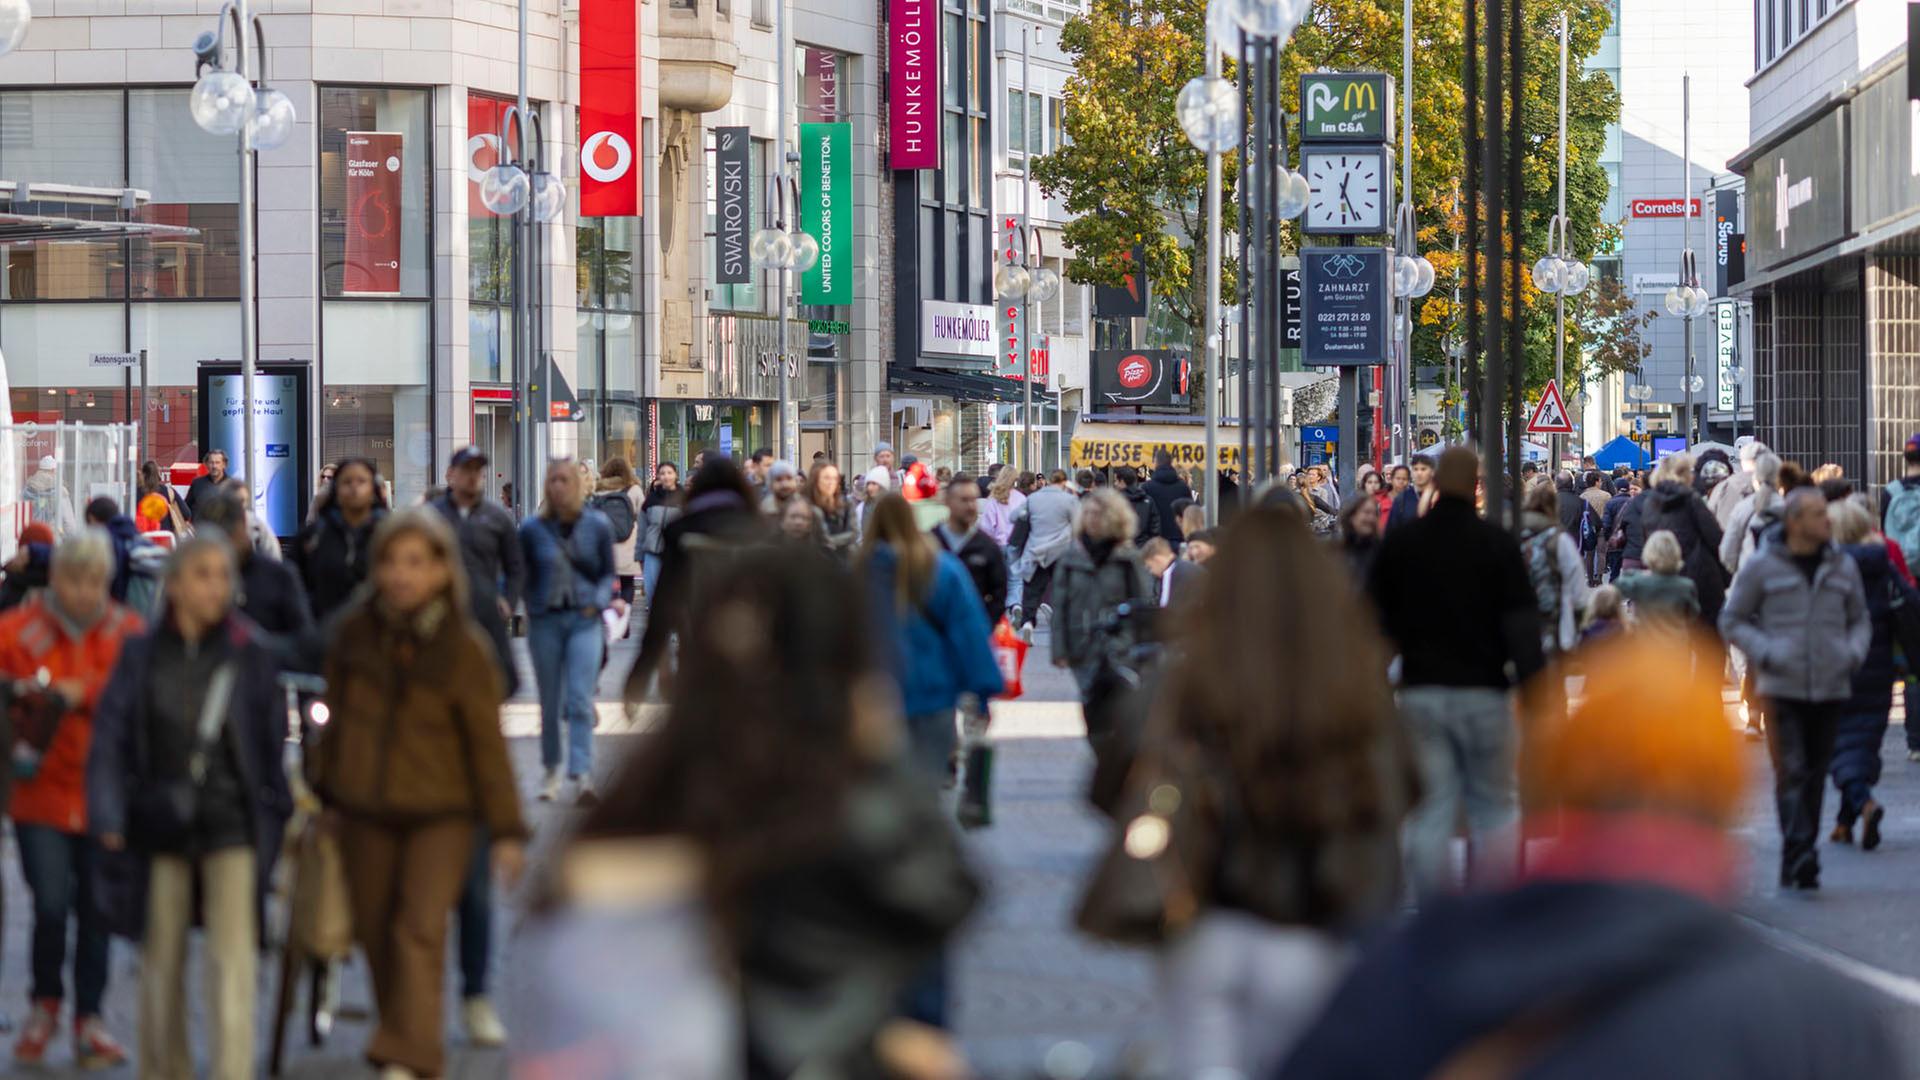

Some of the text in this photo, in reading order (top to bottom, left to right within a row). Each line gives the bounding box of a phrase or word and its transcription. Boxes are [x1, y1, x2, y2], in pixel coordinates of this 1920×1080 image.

[901, 0, 921, 152] HUNKEMÖLL
[1321, 122, 1364, 133] Im C&A
[349, 160, 378, 168] Glasfaser
[724, 160, 743, 275] SWAROVSKI
[822, 136, 832, 293] UNITED COLORS OF BENETTON
[1318, 283, 1370, 292] ZAHNARZT
[1318, 313, 1371, 321] 0221 271 21 20
[934, 310, 990, 341] HUNKEMÖLLER
[1007, 307, 1018, 364] CITY
[95, 355, 136, 365] Antonsgasse
[1721, 309, 1732, 405] REERVED
[1124, 368, 1145, 379] Pizza
[225, 397, 238, 405] Für
[222, 408, 262, 416] gepflte
[1082, 441, 1242, 464] HEISSE MAROEN
